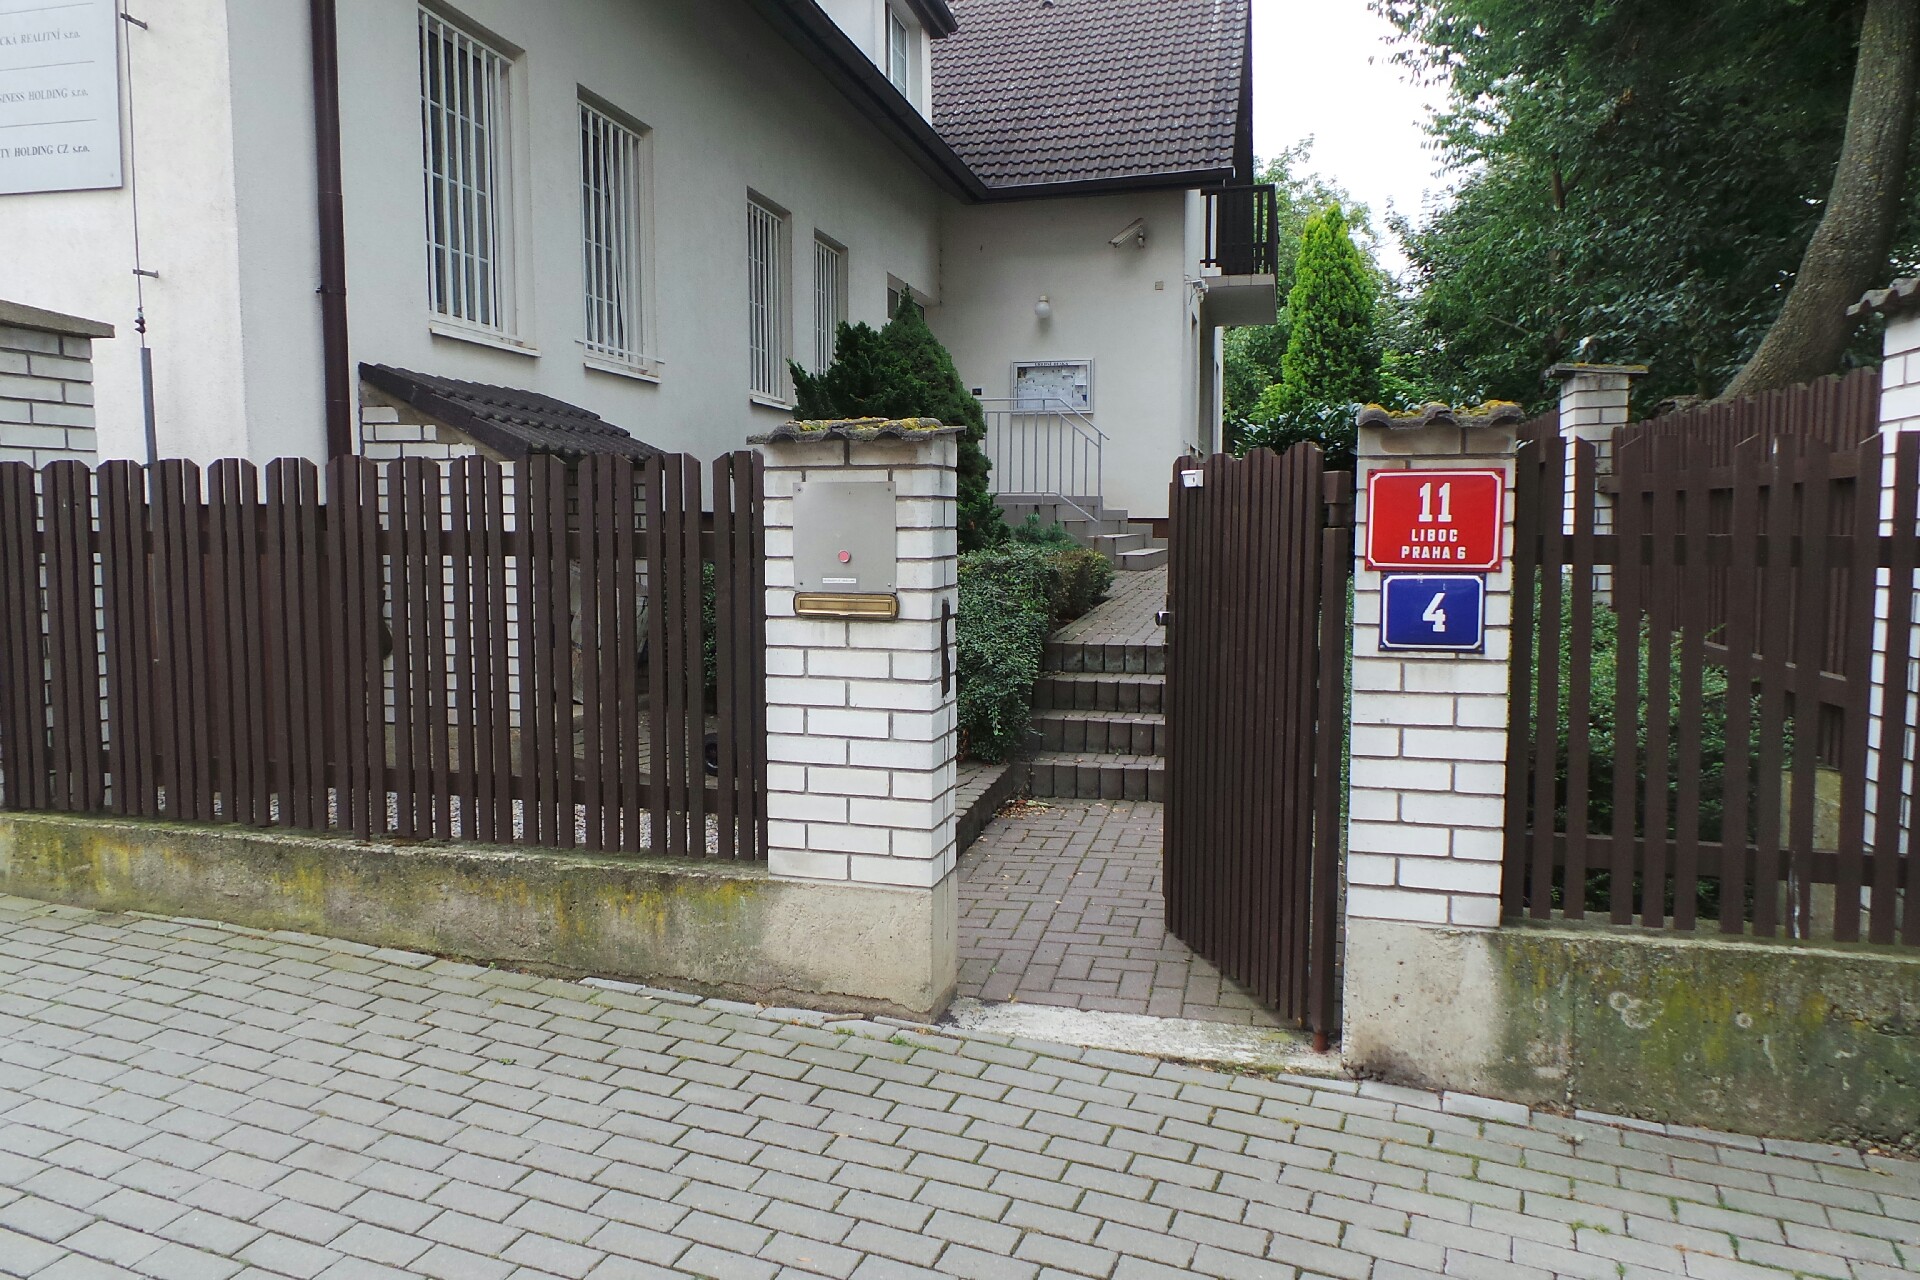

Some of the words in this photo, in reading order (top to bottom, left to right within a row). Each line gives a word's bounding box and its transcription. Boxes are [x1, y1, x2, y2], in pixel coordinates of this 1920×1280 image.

[20, 28, 60, 44] REALITNÍ
[63, 31, 81, 39] s.r.o.
[28, 88, 68, 101] HOLDING
[71, 89, 88, 97] s.r.o.
[14, 145, 53, 157] HOLDING
[57, 144, 69, 154] CZ
[72, 145, 90, 153] s.r.o.
[1418, 482, 1452, 523] 11
[1411, 529, 1458, 542] LIBOC
[1401, 546, 1451, 559] PRAHA
[1457, 546, 1467, 560] 6
[1422, 592, 1446, 632] 4
